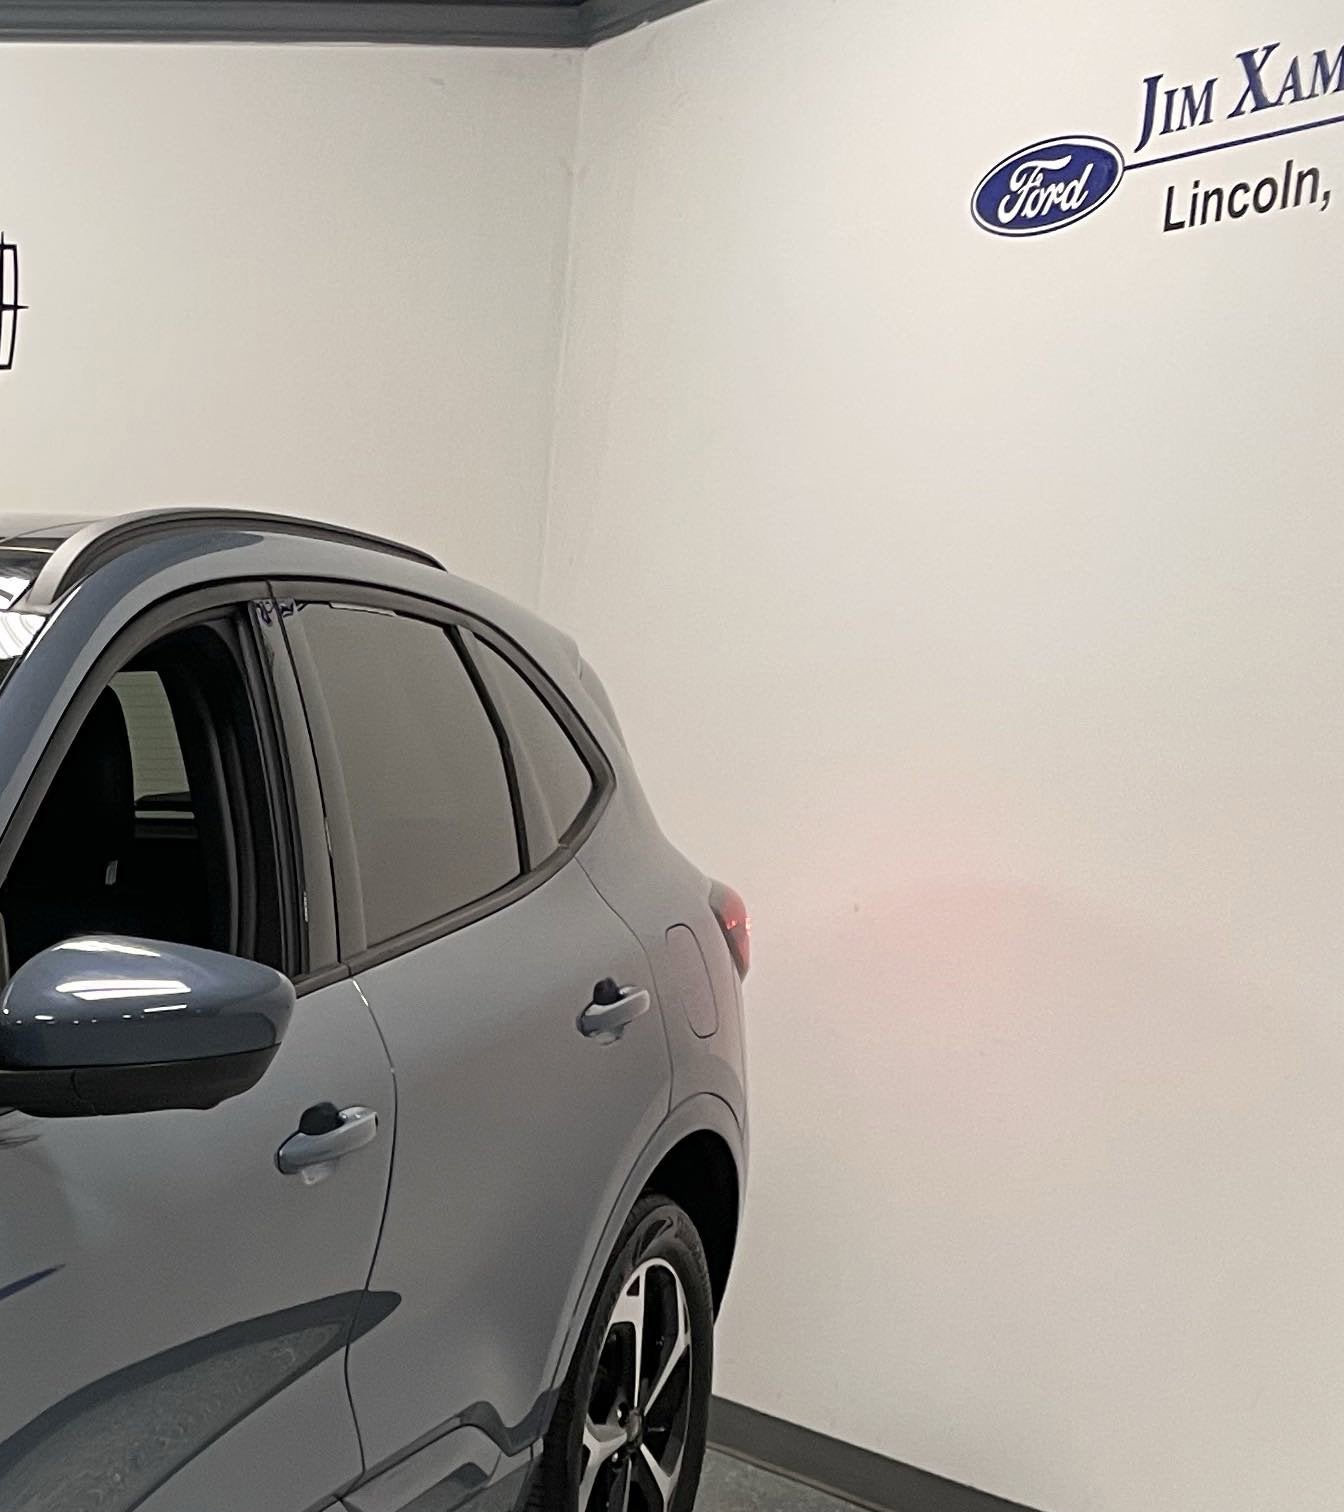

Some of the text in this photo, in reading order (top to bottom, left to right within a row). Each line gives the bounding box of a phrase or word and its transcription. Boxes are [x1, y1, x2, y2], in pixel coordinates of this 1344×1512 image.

[1134, 42, 1344, 154] JIM XAM
[997, 154, 1094, 224] Ford
[1163, 160, 1331, 232] Lincoln,
